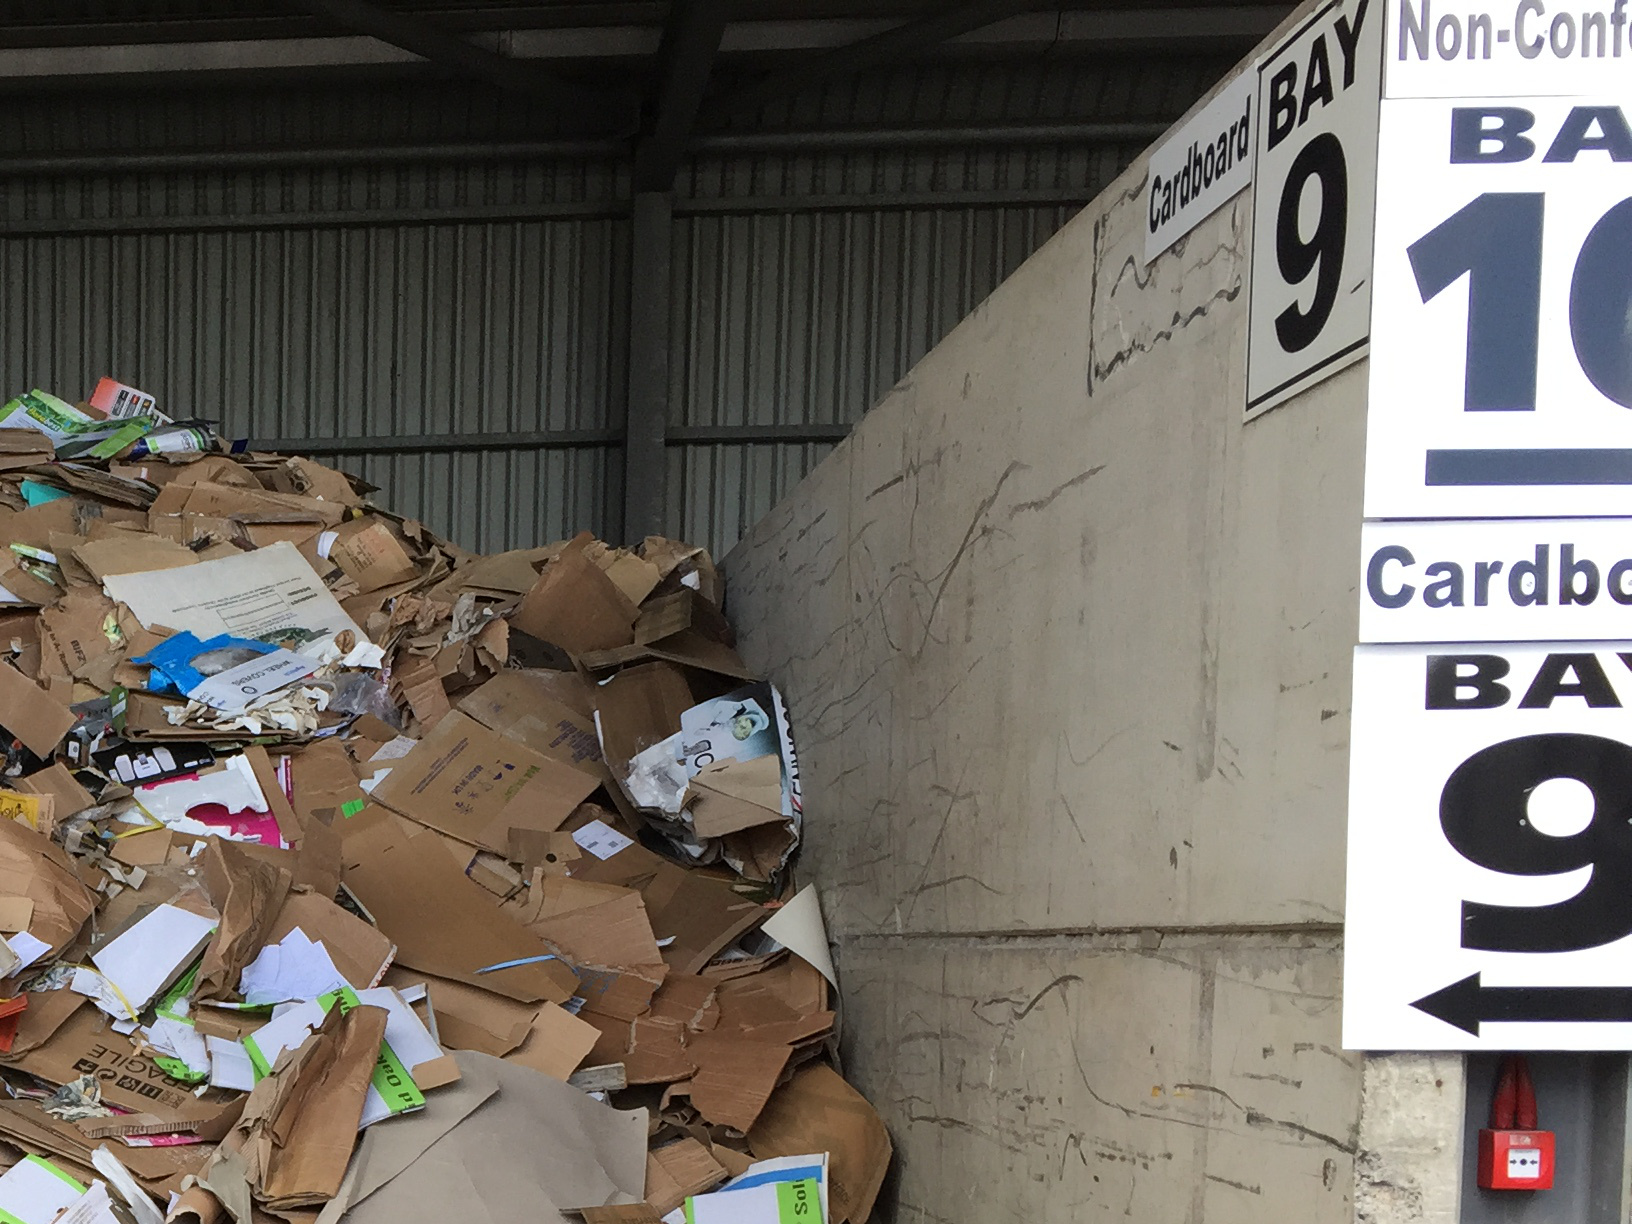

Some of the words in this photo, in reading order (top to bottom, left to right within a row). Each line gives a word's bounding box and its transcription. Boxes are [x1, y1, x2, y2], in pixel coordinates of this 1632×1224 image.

[1267, 2, 1368, 152] BAY
[1398, 0, 1632, 61] Non-Conf
[1148, 96, 1251, 235] Cardboard
[1275, 132, 1348, 354] 9
[1425, 652, 1632, 710] BA
[1439, 732, 1632, 954] 9
